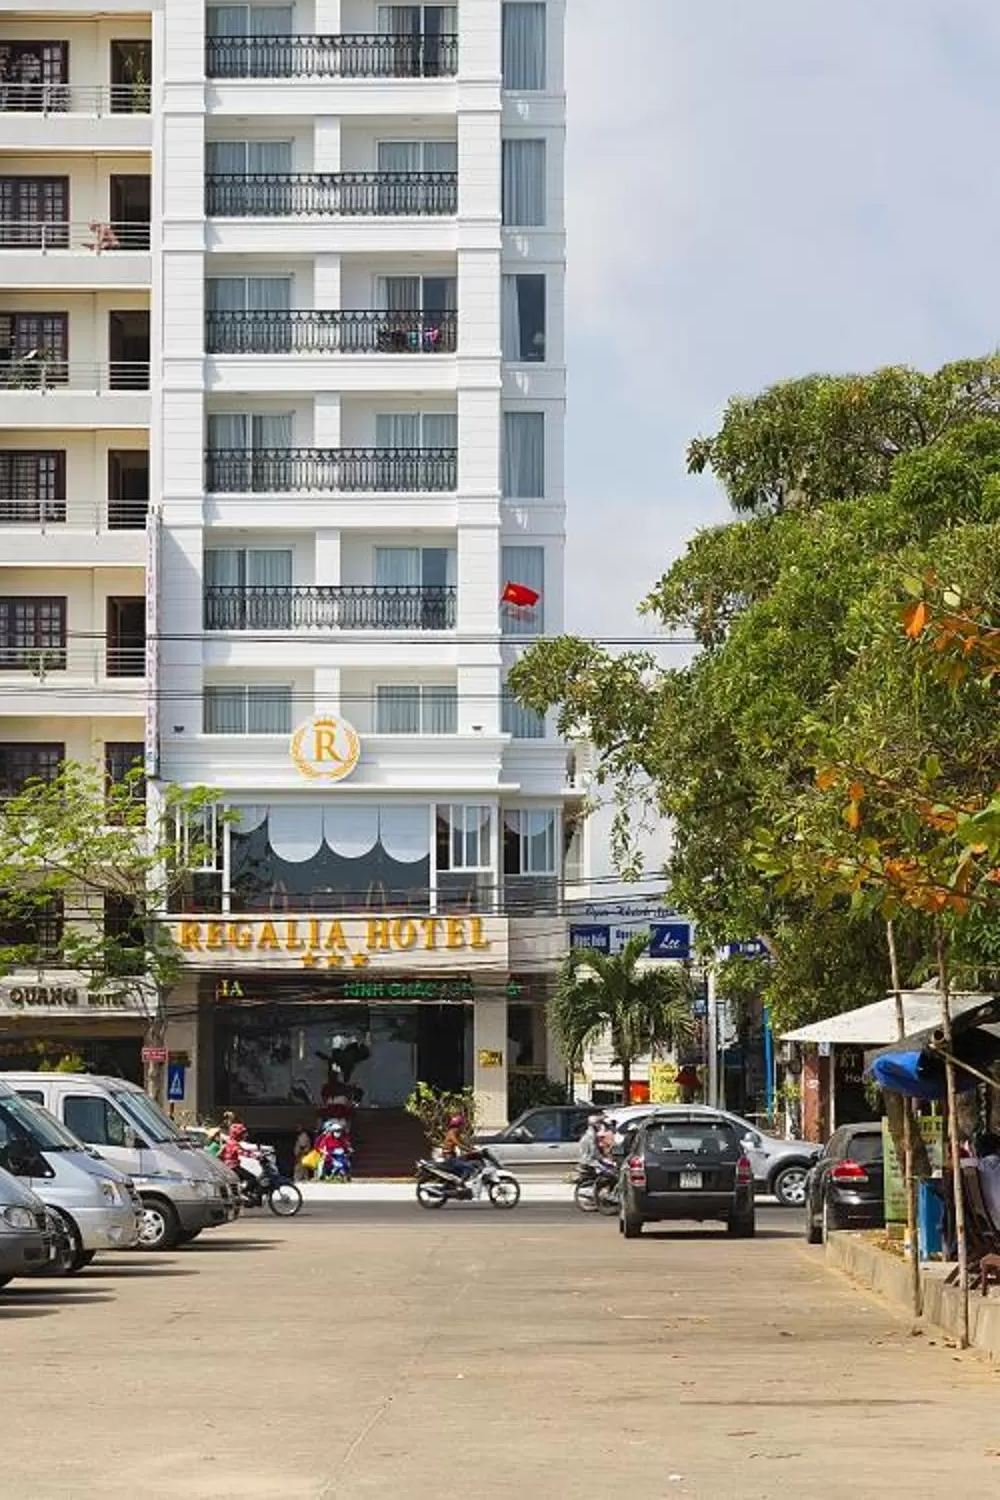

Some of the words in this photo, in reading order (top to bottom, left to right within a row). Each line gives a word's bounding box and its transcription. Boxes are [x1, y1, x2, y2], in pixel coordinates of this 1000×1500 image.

[315, 729, 343, 762] R
[177, 918, 349, 951] REGALIA
[364, 916, 491, 951] HOTEL
[9, 986, 79, 1008] QUANG
